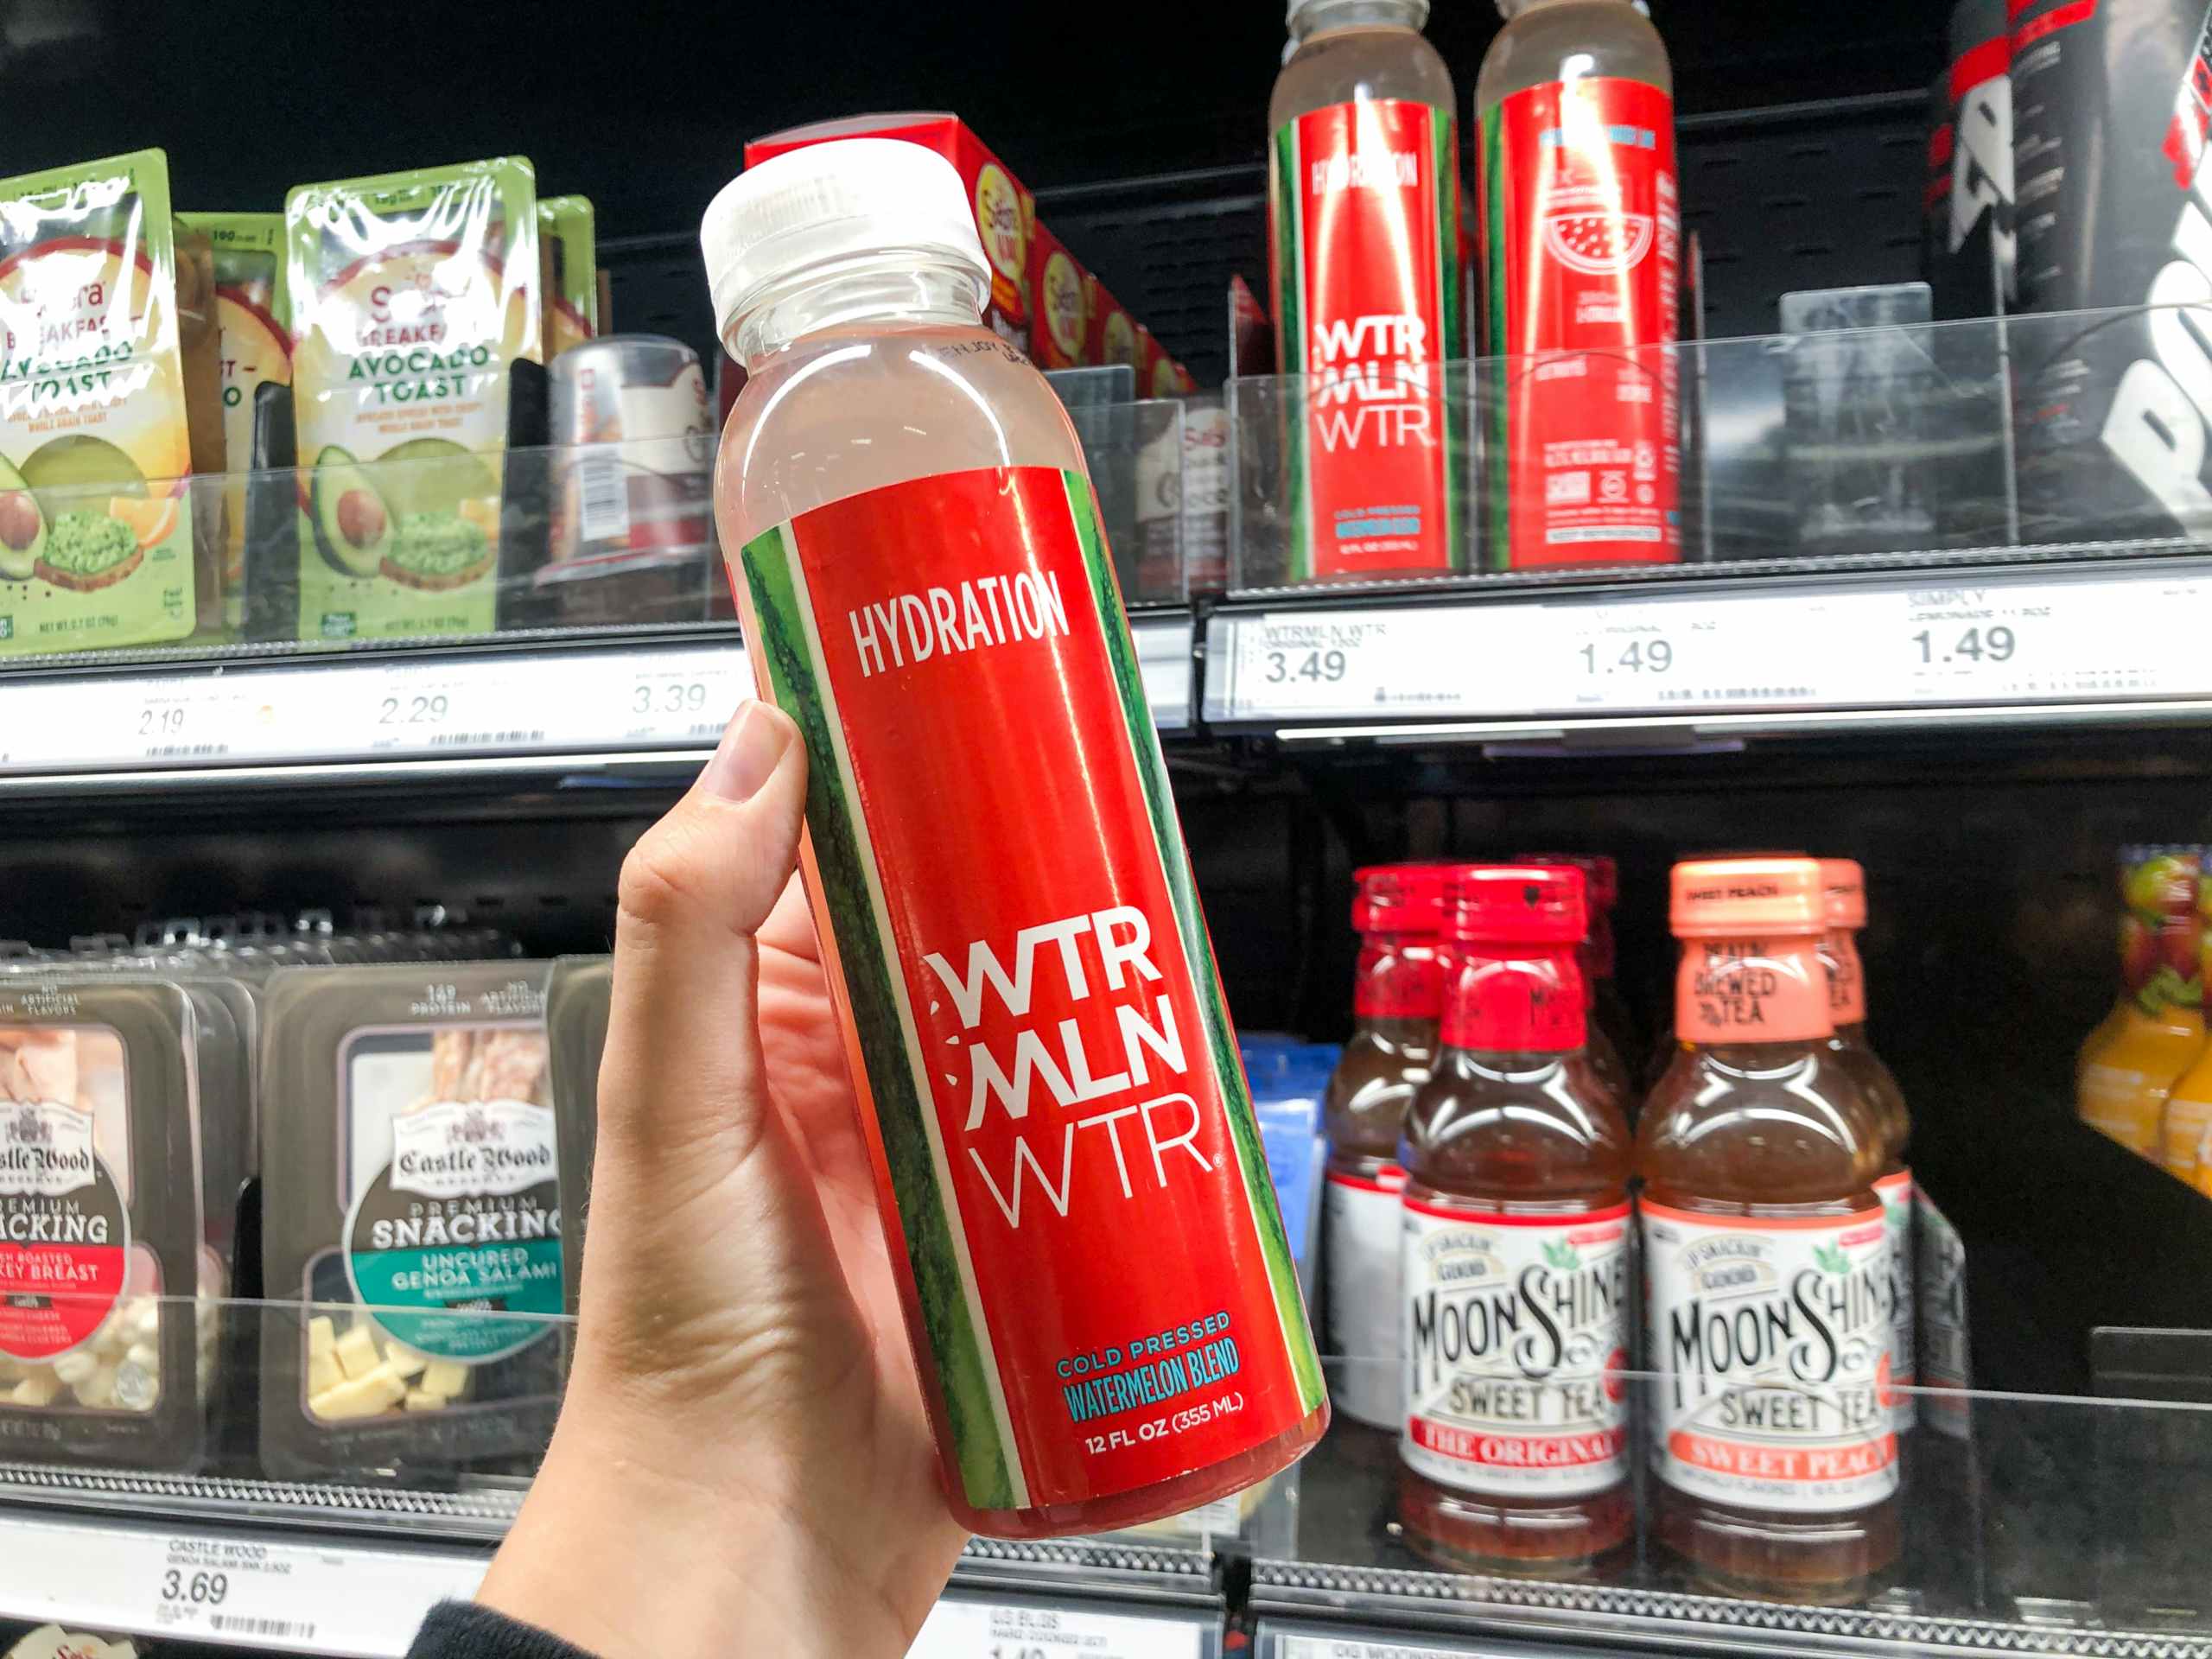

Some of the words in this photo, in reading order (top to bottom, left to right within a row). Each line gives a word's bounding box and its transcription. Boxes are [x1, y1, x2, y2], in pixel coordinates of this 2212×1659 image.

[1314, 315, 1427, 362] WTR
[349, 344, 490, 379] AVOCADO
[373, 374, 465, 404] TOAST
[1316, 359, 1429, 408] MLN
[1314, 404, 1438, 453] WTR
[849, 570, 1070, 678] HYDRATION
[1579, 639, 1674, 675] 1.49
[1911, 626, 2017, 664] 1.49
[1265, 650, 1347, 683] 3.49
[378, 694, 449, 725] 2.29
[632, 683, 708, 715] 3.39
[138, 708, 185, 736] 2.19
[923, 906, 1163, 1030] WTR
[1721, 997, 1765, 1024] TEA
[964, 994, 1188, 1132] MLN
[399, 1149, 477, 1174] Castle
[968, 1092, 1214, 1230] WTR
[410, 1196, 537, 1219] PREMIUM
[391, 1269, 471, 1290] GENOA
[479, 1261, 557, 1281] SALAMI
[422, 1246, 529, 1271] UNCURED
[1057, 1347, 1122, 1378] COLD
[1128, 1310, 1231, 1360] PRESSED
[1063, 1354, 1189, 1423] WATERMELON
[1186, 1337, 1240, 1389] BLEND
[1449, 1377, 1544, 1420] SWEET
[1085, 1434, 1107, 1455] 12
[1109, 1429, 1135, 1450] FL
[1139, 1418, 1169, 1441] OZ
[1172, 1403, 1211, 1433] (355
[1211, 1391, 1244, 1418] ML)
[1719, 1388, 1821, 1432] SWEET
[1424, 1423, 1476, 1458] THE
[1691, 1440, 1801, 1477] SWEET
[168, 1539, 220, 1556] CASTLE
[162, 1568, 229, 1605] 3.69
